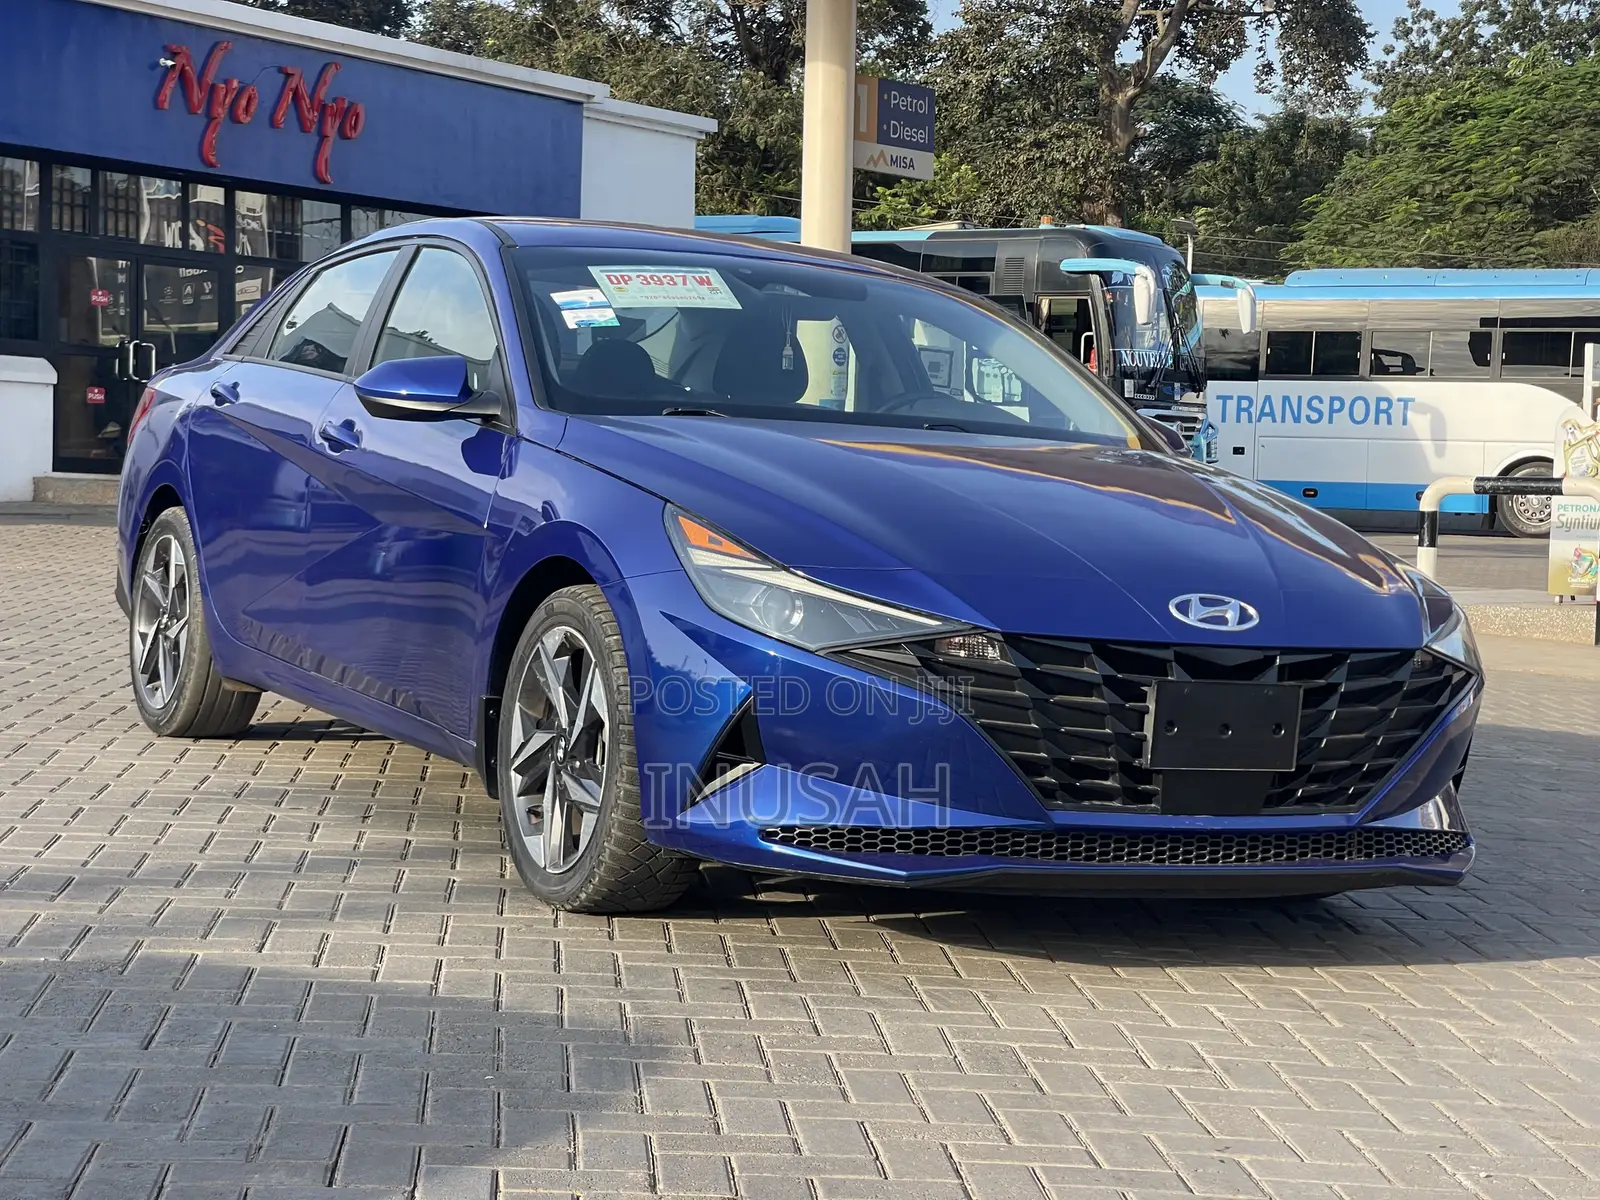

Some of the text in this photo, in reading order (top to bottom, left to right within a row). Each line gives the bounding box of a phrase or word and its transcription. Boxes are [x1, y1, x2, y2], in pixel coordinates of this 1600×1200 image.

[890, 90, 928, 115] Petrol
[157, 41, 364, 184] Nyo Nyo
[890, 120, 928, 144] Diesel
[890, 154, 915, 171] MISA
[605, 273, 713, 287] DP 3937 W
[91, 294, 108, 302] PUSH
[88, 392, 105, 400] PUSH
[1216, 394, 1415, 426] TRANSPORT
[1556, 513, 1600, 532] Syntiu
